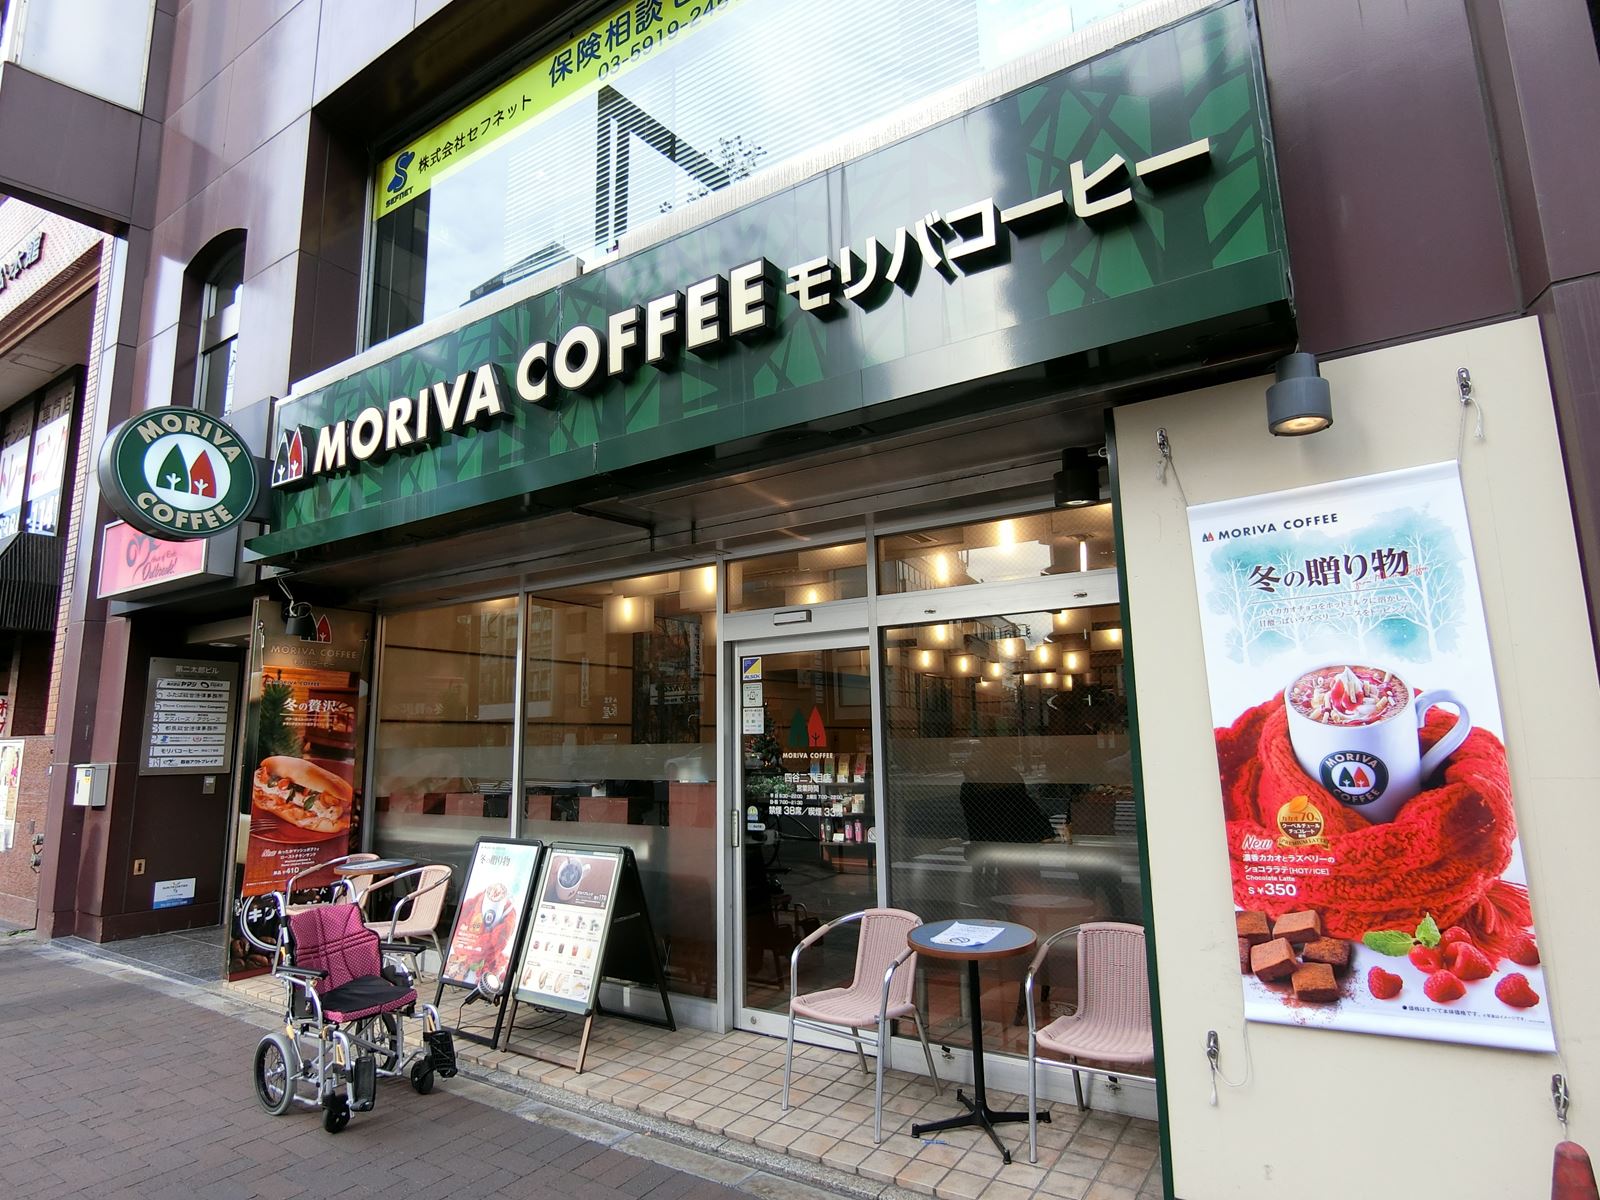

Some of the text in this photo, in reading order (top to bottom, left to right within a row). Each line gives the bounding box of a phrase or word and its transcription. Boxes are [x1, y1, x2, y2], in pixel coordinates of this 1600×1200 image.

[418, 94, 532, 174] 株式会社セフネット
[786, 137, 1211, 312] モリバコーヒー
[313, 258, 767, 476] MORIVA COFFEE
[136, 414, 242, 464] MORIVA
[137, 492, 233, 530] COFFEE
[1218, 513, 1338, 540] MORIVA COFFEE
[1248, 548, 1408, 593] 冬の贈り物
[271, 645, 357, 659] MORIVA COFFEE
[1325, 753, 1378, 768] MORIVA
[1333, 788, 1380, 803] COFFEE
[1242, 834, 1273, 850] New
[1244, 865, 1288, 874] ショコララテ
[1248, 886, 1255, 895] S
